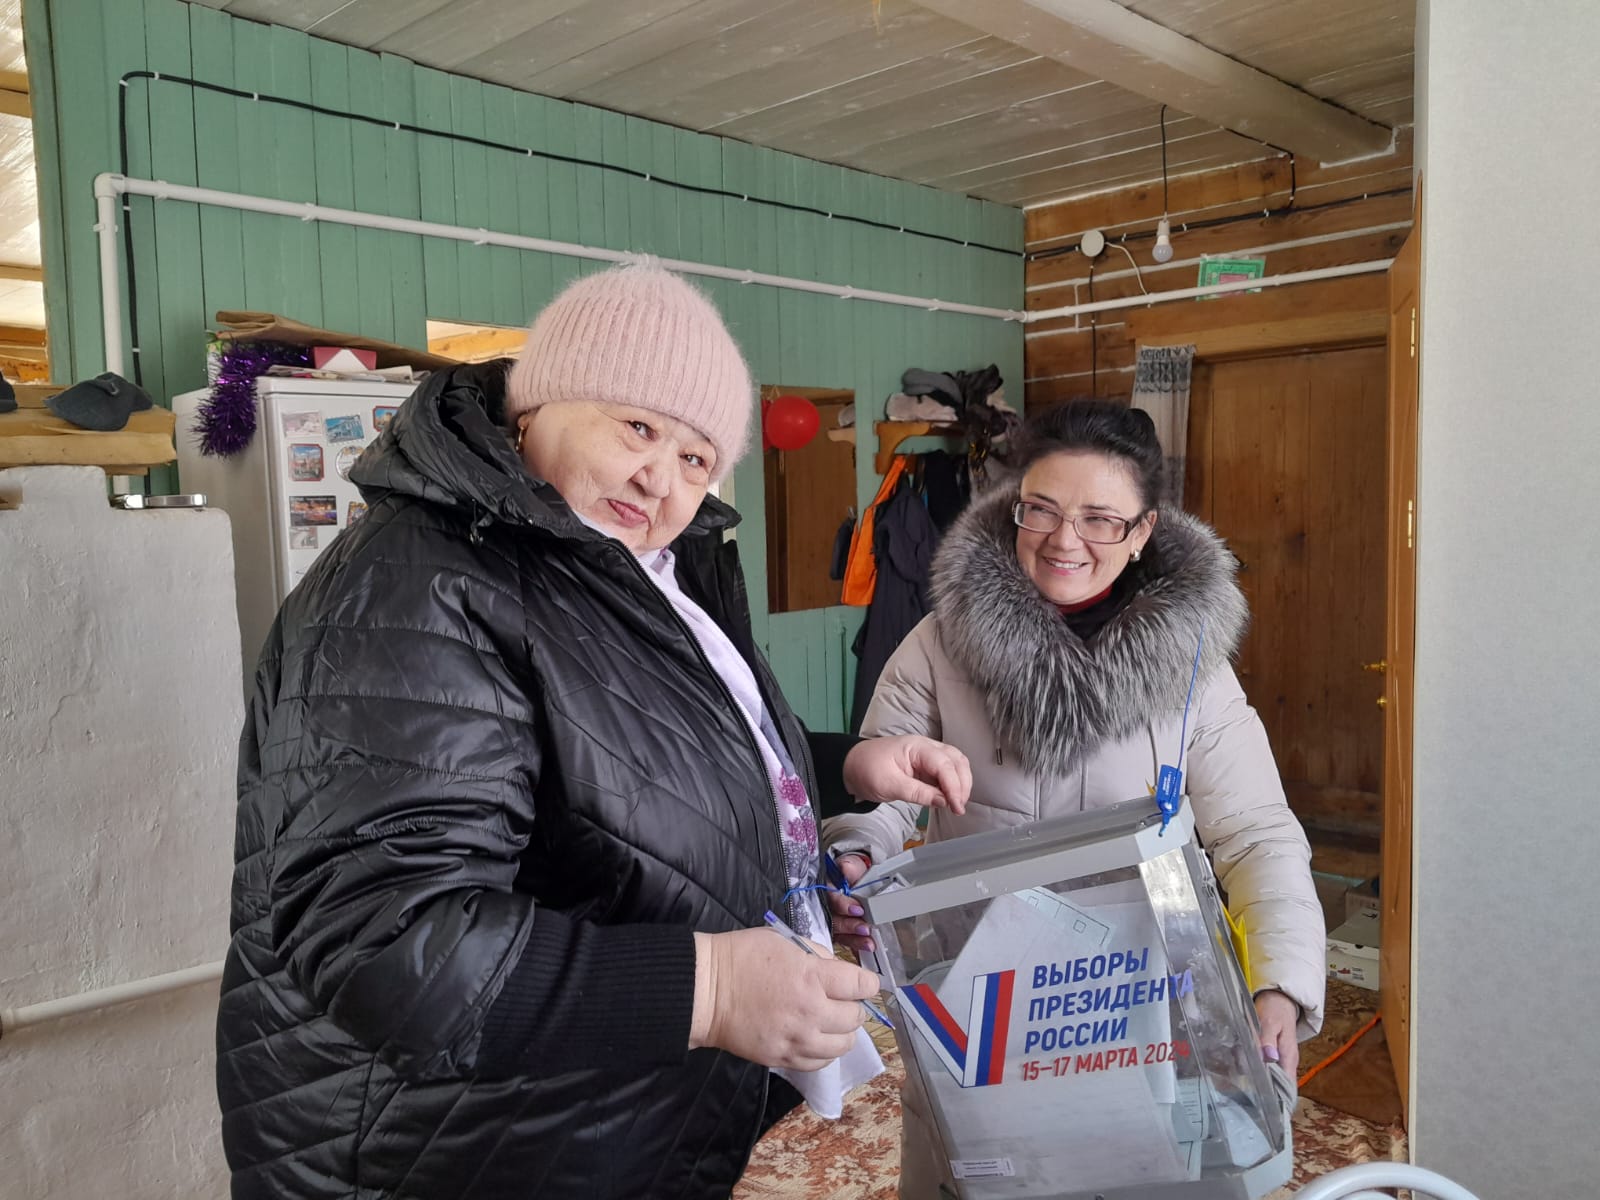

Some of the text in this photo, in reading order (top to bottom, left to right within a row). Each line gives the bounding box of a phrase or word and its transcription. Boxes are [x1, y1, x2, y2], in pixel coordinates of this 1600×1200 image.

[1032, 947, 1149, 989] ВЫБОРЫ
[1028, 968, 1194, 1022] ПРЕЗИДЕНТА
[1024, 1016, 1128, 1054] РОССИИ
[1074, 1046, 1138, 1074] МАРТА
